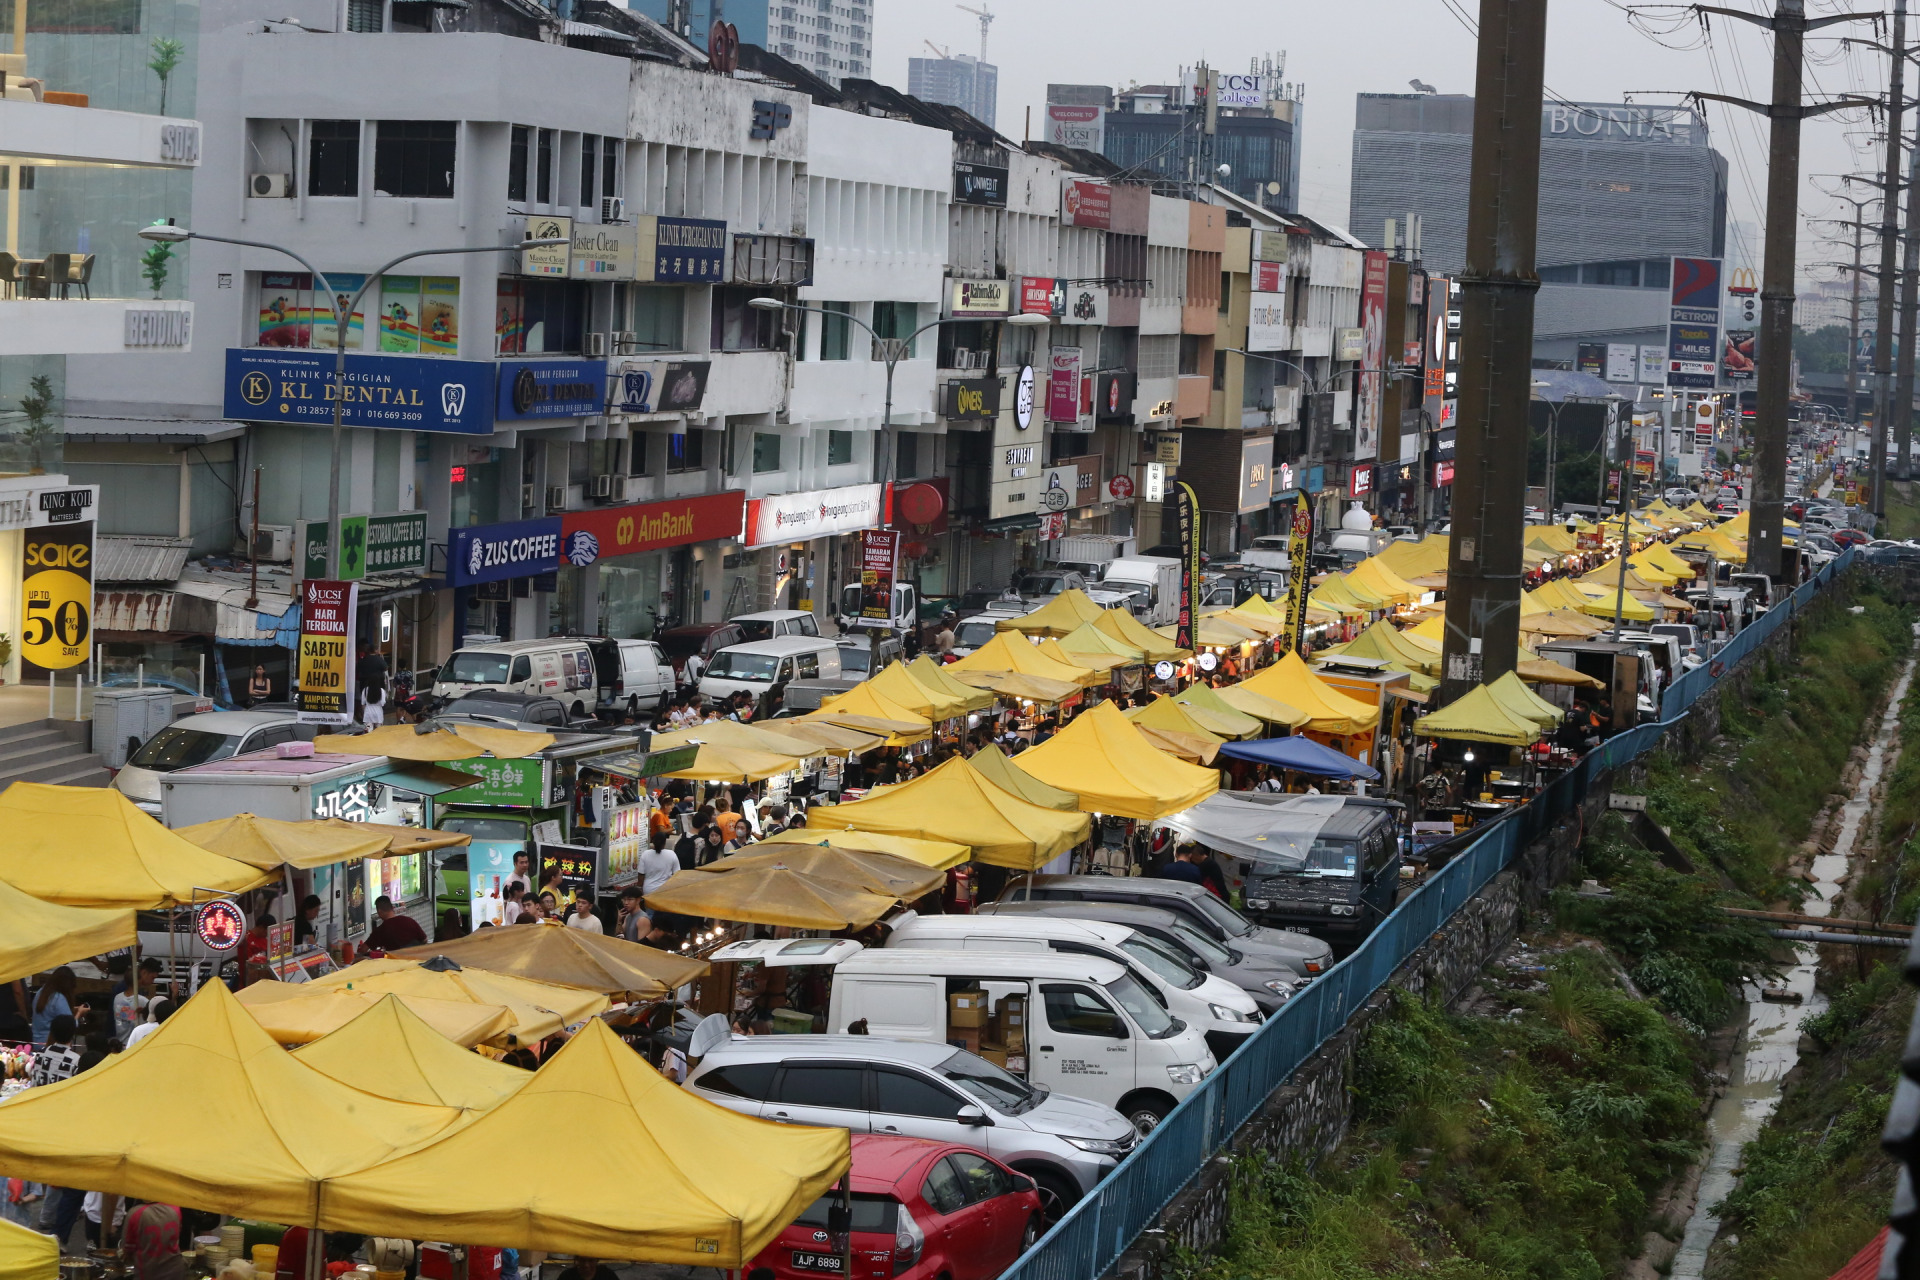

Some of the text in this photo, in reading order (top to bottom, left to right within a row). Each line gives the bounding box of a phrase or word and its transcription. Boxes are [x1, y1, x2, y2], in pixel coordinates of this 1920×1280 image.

[1217, 76, 1260, 90] UCSI
[1217, 91, 1260, 106] College
[1551, 107, 1672, 139] BONIA
[1065, 130, 1089, 140] UCSI
[163, 125, 199, 161] SOFA
[573, 232, 619, 252] aster Clean
[658, 224, 724, 248] KLINIK PERGIGIAN SUM
[529, 254, 546, 262] Master
[1674, 310, 1716, 322] PETRON
[127, 311, 190, 346] BEDDING
[1682, 344, 1710, 354] MILES
[1703, 364, 1714, 372] 100
[281, 370, 392, 383] KLINIK PRGIGIAN
[280, 382, 424, 406] KL DENTAL
[297, 405, 307, 414] 03
[310, 406, 330, 416] 2857
[368, 410, 382, 418] 016
[384, 411, 400, 420] 669
[402, 412, 422, 421] 3609
[43, 492, 92, 510] KING KOIL
[52, 513, 74, 522] MATTRESS
[392, 521, 410, 542] COFFEE
[414, 520, 424, 540] TEA
[638, 508, 695, 542] AmBank
[26, 542, 90, 568] sale
[484, 534, 557, 566] ZUS COFFEE
[864, 554, 890, 562] BIASISWA
[28, 590, 50, 600] UP TO
[317, 590, 342, 600] UCSI
[318, 598, 342, 606] University
[314, 608, 336, 620] HARI
[862, 610, 888, 618] SEPTEMBER
[306, 620, 345, 632] TERBUKA
[62, 647, 80, 656] SAVE
[304, 640, 344, 658] SABTU
[312, 658, 330, 670] DAN
[306, 671, 340, 688] AHAD
[304, 694, 340, 705] KAMPUS KL
[798, 1254, 840, 1268] AJP 6899
